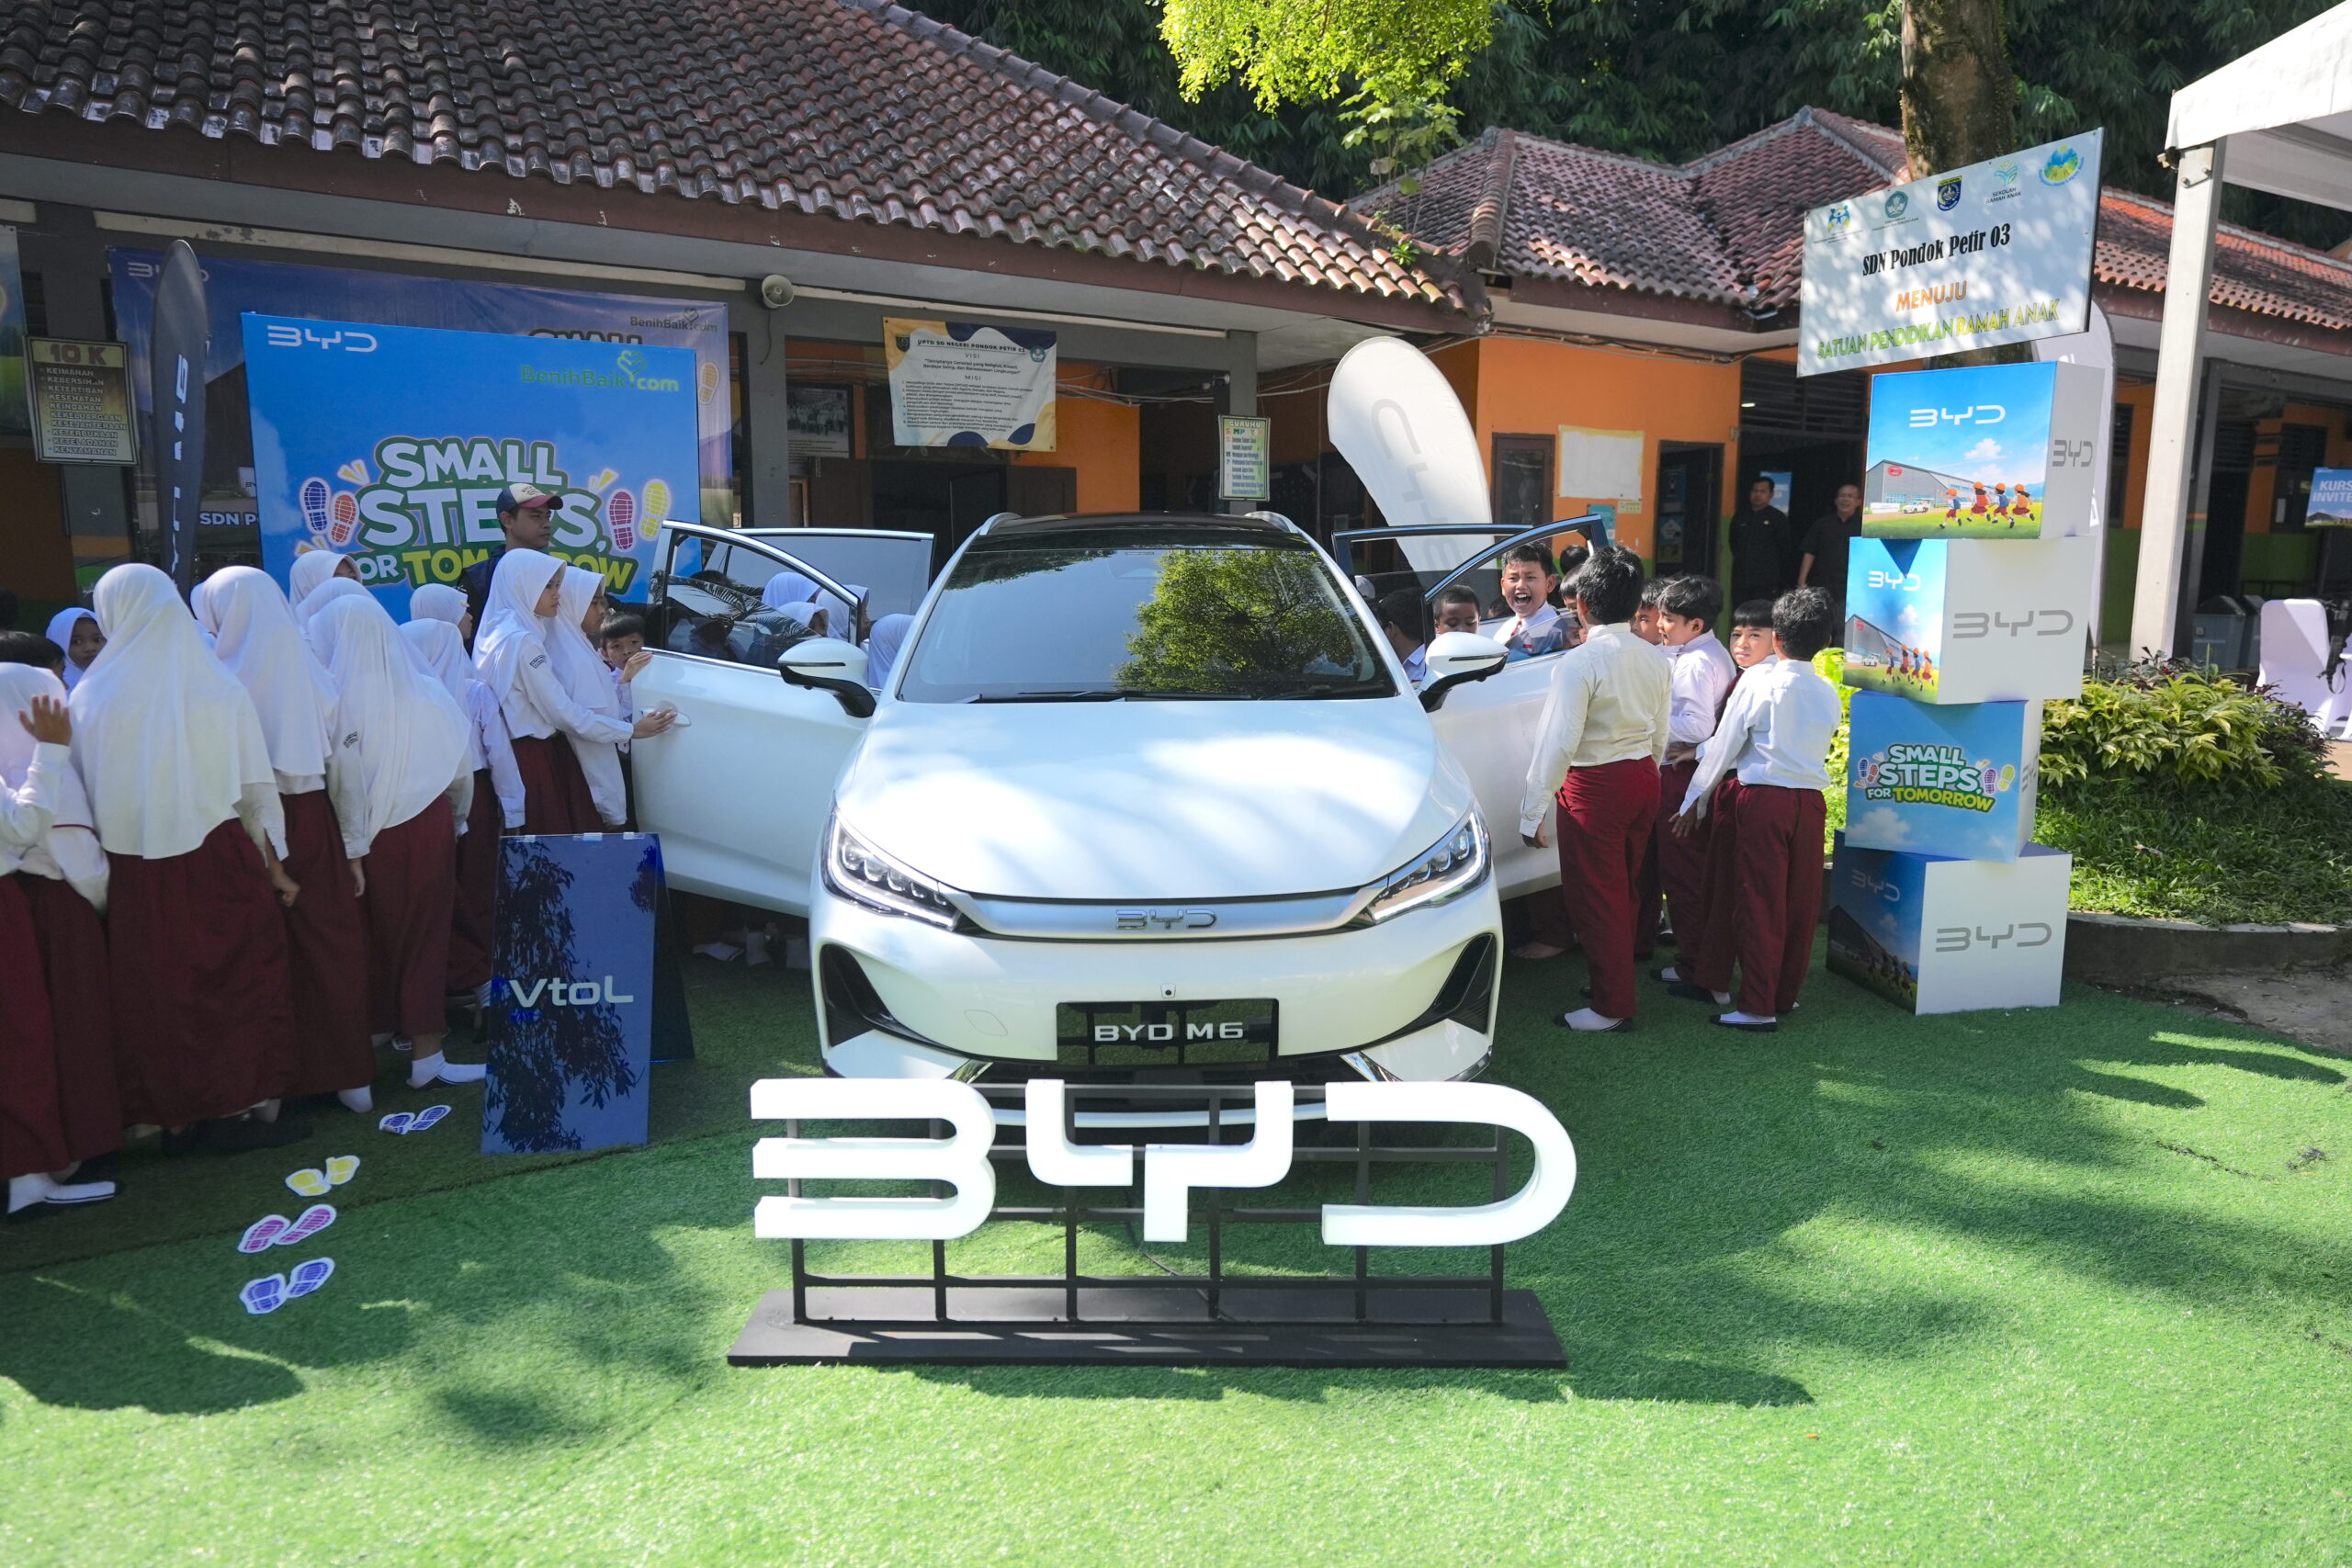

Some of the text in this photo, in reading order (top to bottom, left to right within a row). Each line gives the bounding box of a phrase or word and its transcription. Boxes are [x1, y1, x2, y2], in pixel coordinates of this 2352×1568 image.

[1862, 223, 2011, 276] SDN Pondok Petir 03
[1895, 280, 1968, 312] MENUJU
[266, 324, 378, 354] BYD
[1816, 299, 2060, 359] SATUAN PENDIDIKAN RAMAH ANAK
[50, 343, 107, 366] 10 K
[1909, 404, 2007, 428] BYD
[380, 442, 563, 489] SMALL
[2052, 438, 2094, 468] BYD
[199, 513, 240, 525] SDN
[359, 488, 607, 553] STES,
[359, 554, 400, 579] OR
[1868, 570, 1921, 593] BYD
[1952, 608, 2074, 639] BYD
[1889, 745, 1965, 767] SMALL
[1867, 787, 1994, 813] FOR TOMORROW
[1851, 868, 1901, 902] BYD
[1115, 908, 1218, 931] BYD
[1935, 921, 2052, 953] BYD
[508, 975, 634, 1009] VtoL
[1094, 1021, 1244, 1042] BYD M6
[750, 1077, 1578, 1247] BYD
